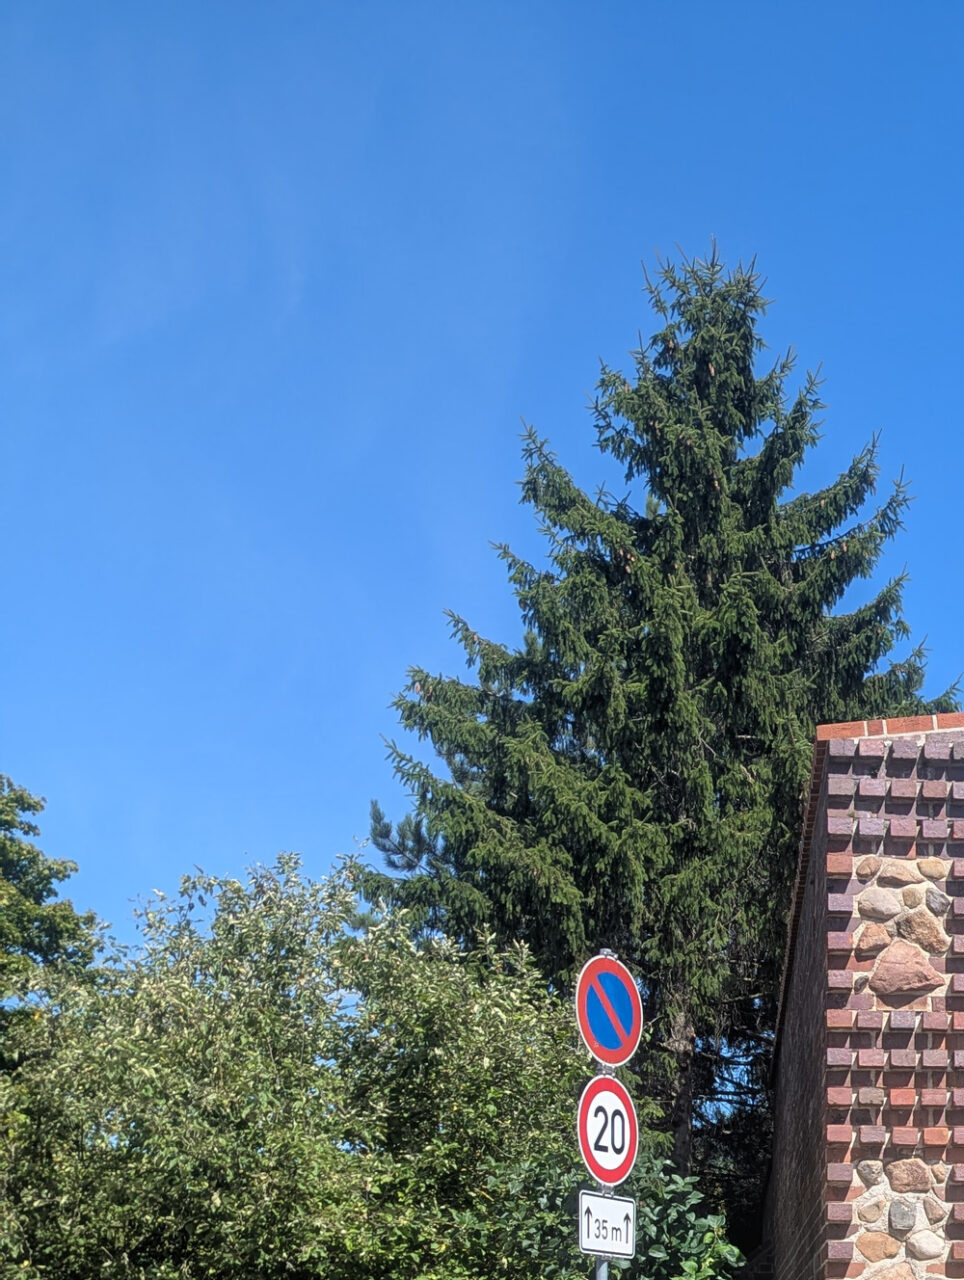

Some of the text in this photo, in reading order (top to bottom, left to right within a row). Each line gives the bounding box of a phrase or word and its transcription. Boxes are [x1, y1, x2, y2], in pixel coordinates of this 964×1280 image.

[593, 1105, 625, 1155] 20
[594, 1217, 622, 1242] 35 m
